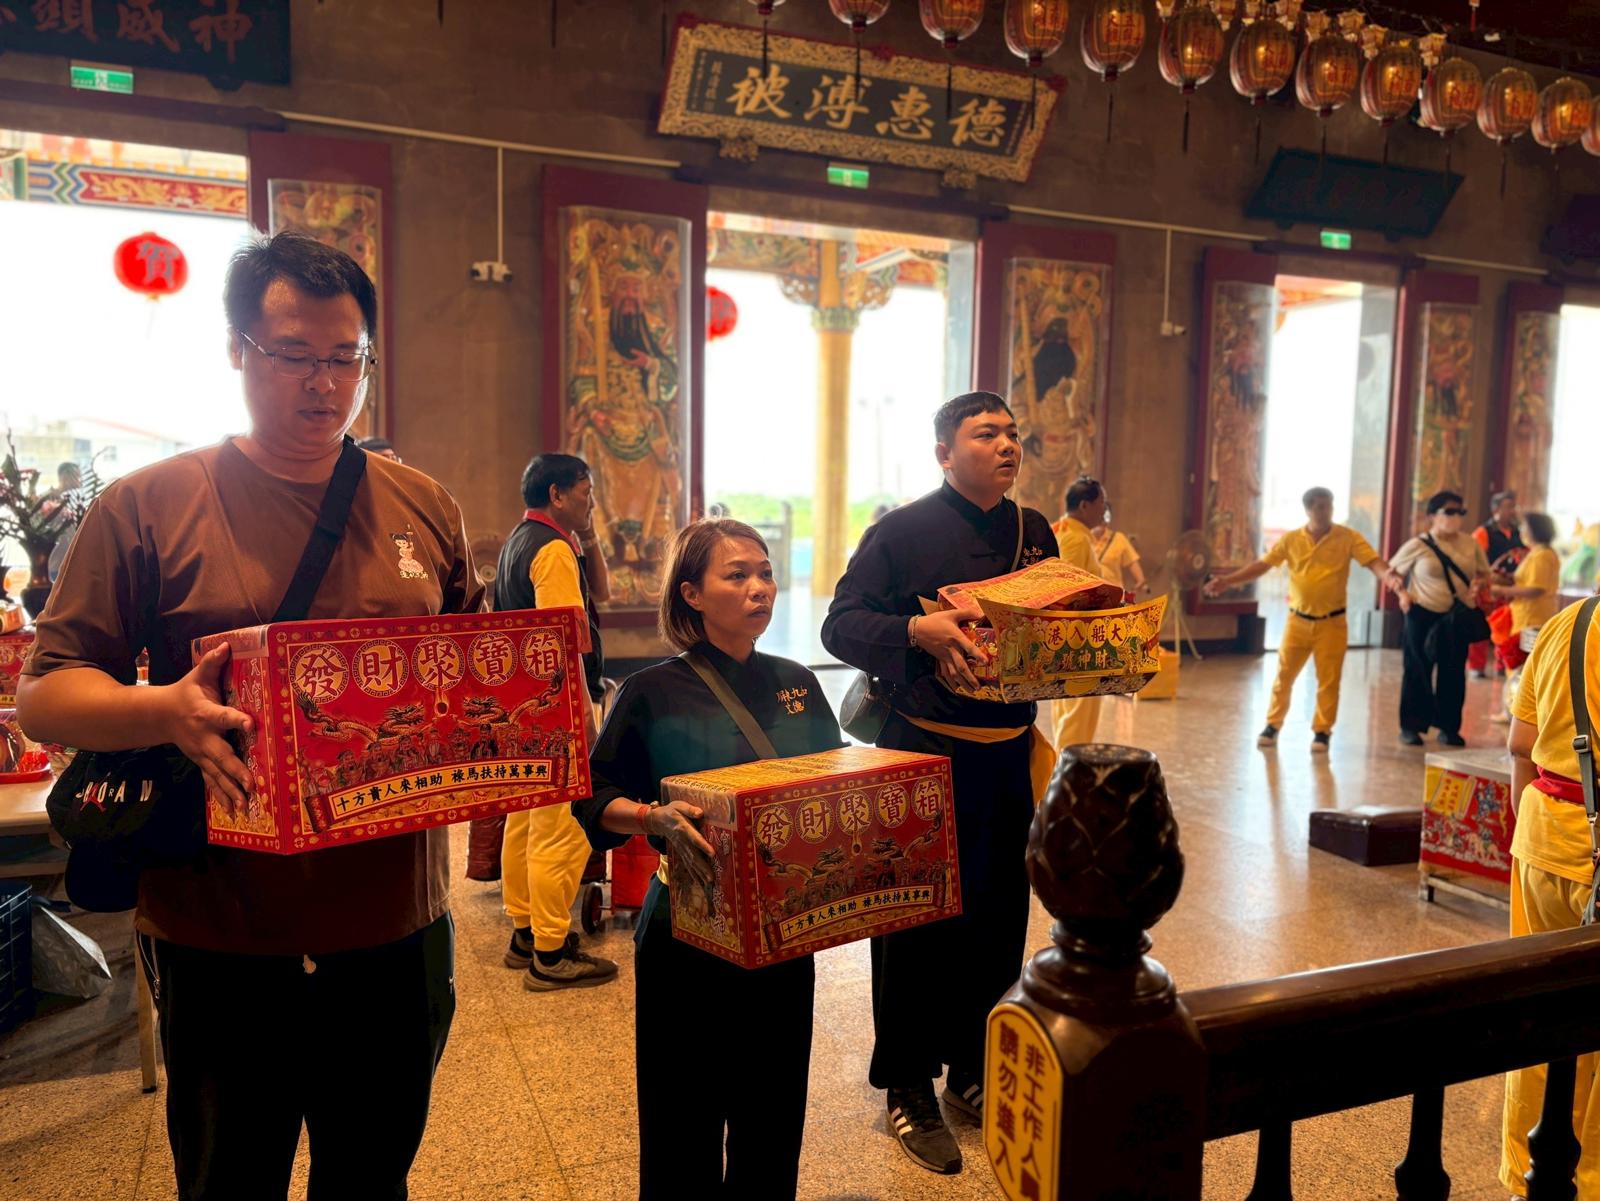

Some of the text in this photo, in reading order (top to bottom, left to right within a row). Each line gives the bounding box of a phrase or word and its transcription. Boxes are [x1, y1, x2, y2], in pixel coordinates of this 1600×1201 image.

[296, 632, 563, 700] 發財聚寶箱
[758, 780, 944, 846] 發財聚寶箱
